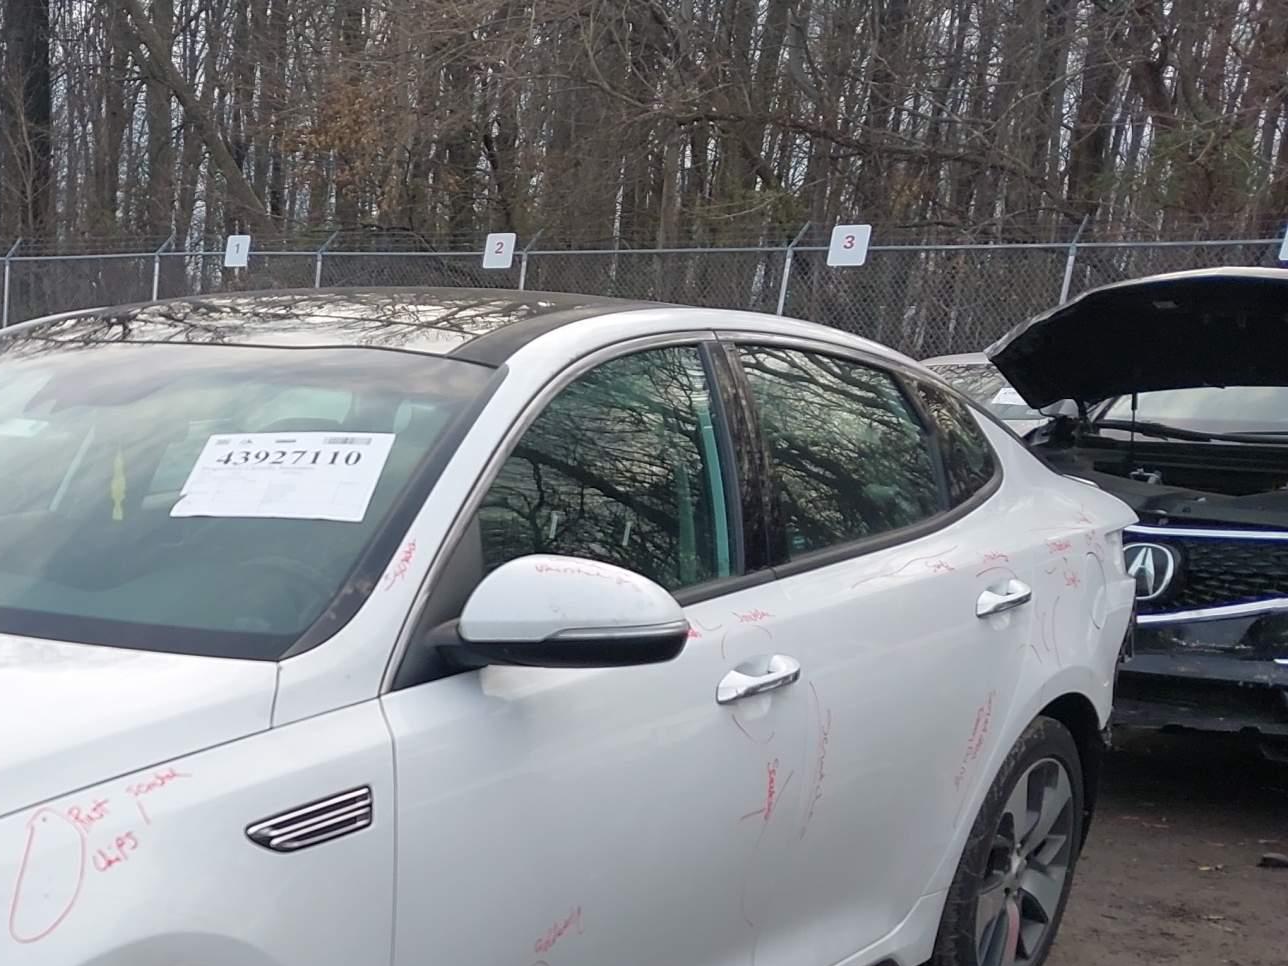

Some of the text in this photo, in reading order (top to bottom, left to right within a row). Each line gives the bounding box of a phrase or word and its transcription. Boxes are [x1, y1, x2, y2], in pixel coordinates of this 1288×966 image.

[232, 243, 240, 254] 1
[495, 241, 505, 255] 2
[843, 235, 855, 249] 3
[215, 450, 362, 466] 43927110
